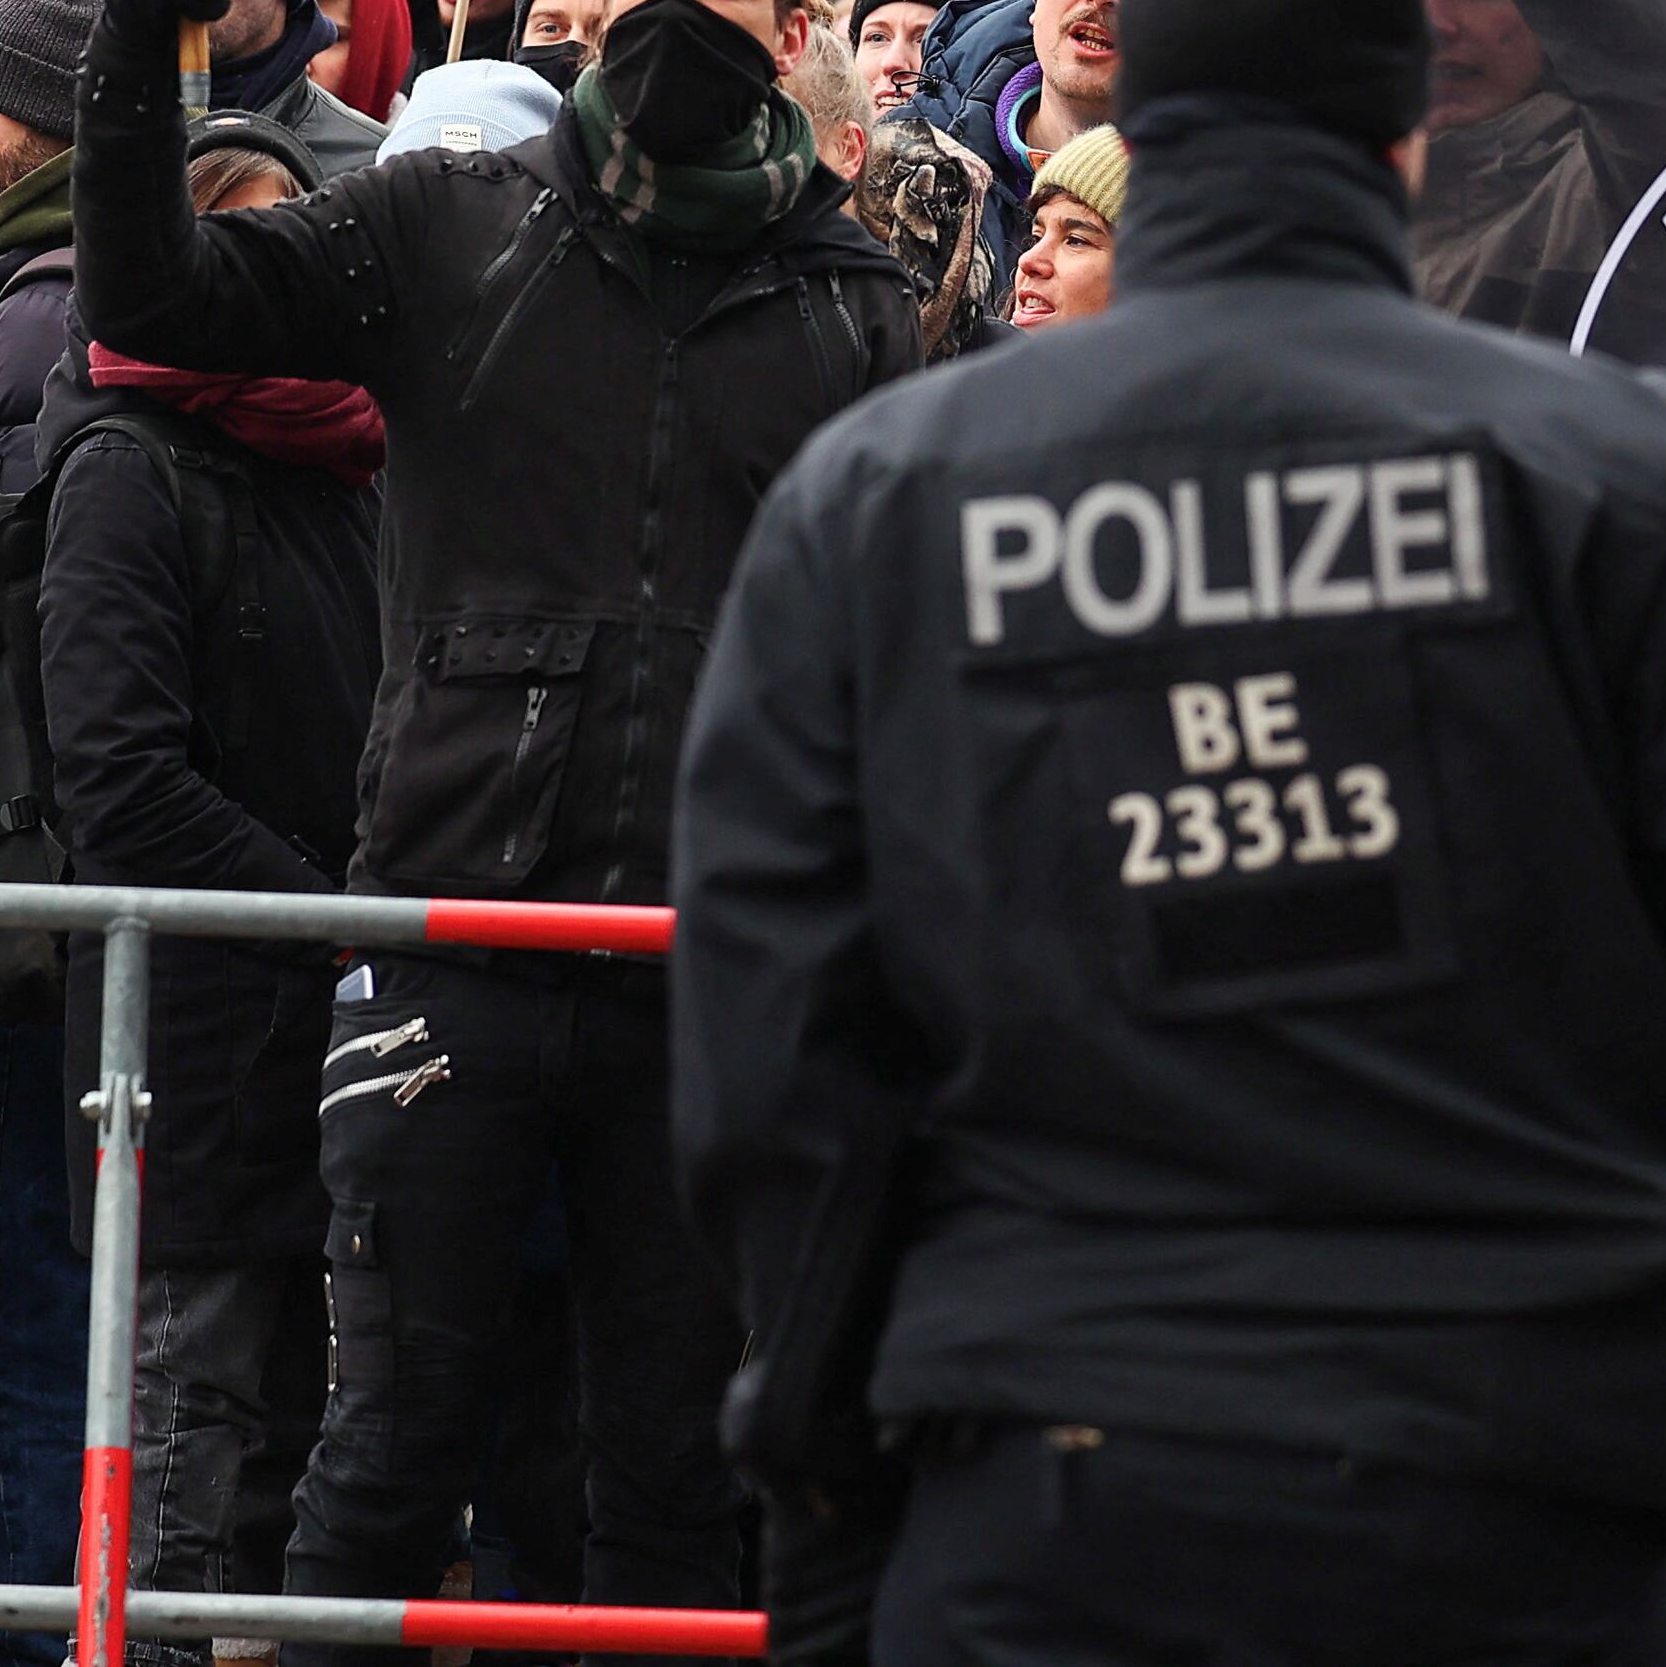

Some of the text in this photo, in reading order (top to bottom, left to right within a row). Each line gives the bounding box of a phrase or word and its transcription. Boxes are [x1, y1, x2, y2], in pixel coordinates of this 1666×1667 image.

[445, 131, 477, 139] MSCH
[959, 455, 1490, 646] POLIZEI
[1169, 672, 1308, 774] BE
[1108, 765, 1400, 886] 23313
